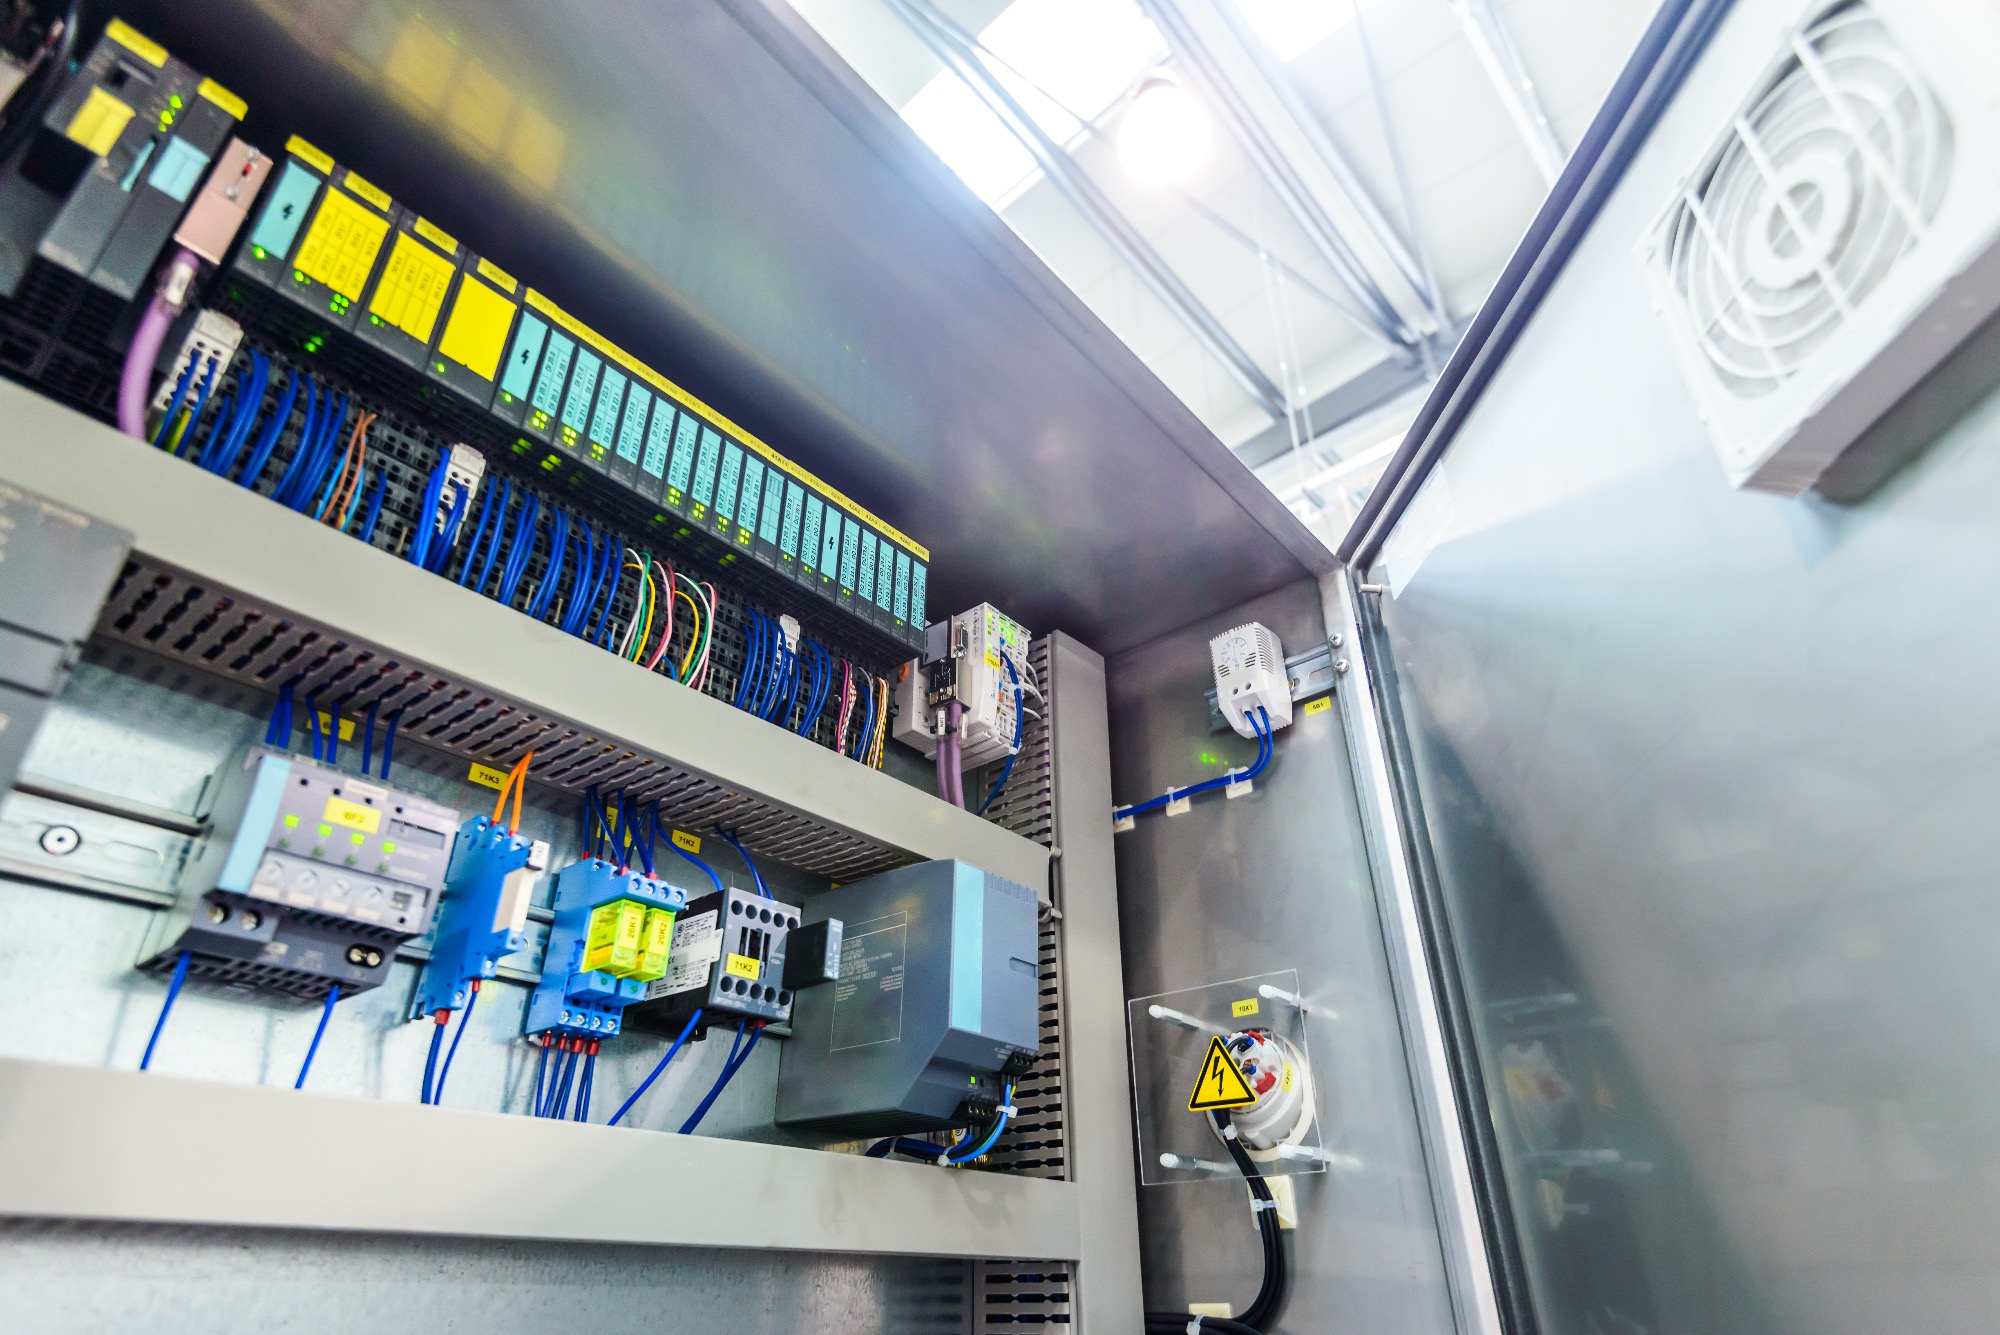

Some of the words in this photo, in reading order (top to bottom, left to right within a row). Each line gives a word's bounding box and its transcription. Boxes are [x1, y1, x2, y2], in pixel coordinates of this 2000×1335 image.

[545, 363, 552, 372] DI
[556, 370, 564, 380] DI
[573, 378, 580, 387] DI
[584, 385, 592, 394] DI
[536, 394, 543, 403] DI
[599, 397, 606, 406] DI
[548, 401, 555, 411] DI
[610, 404, 617, 413] DI
[565, 409, 572, 418] DI
[626, 413, 632, 422] DI
[576, 416, 584, 425] DI
[636, 420, 643, 429] DI
[592, 428, 598, 437] DI
[651, 428, 657, 437] DI
[602, 434, 610, 443] DI
[661, 435, 668, 443] DI
[619, 443, 626, 452] DI
[676, 443, 682, 452] DI
[630, 450, 636, 459] DI
[685, 449, 691, 458] DI
[645, 458, 651, 467] DI
[699, 458, 705, 466] DI
[770, 452, 787, 467] 41A11
[655, 464, 662, 473] DI
[708, 464, 715, 472] DI
[670, 473, 676, 481] DI
[722, 471, 727, 480] DI
[680, 479, 686, 487] DI
[731, 477, 737, 485] DI
[694, 487, 700, 496] DI
[744, 485, 749, 493] DI
[704, 493, 710, 501] DI
[752, 490, 758, 498] DI
[717, 501, 723, 509] DI
[848, 502, 860, 514] 42A2
[726, 506, 732, 514] DI
[739, 514, 745, 522] DI
[748, 519, 754, 527] DI
[479, 772, 500, 784] 71K3
[678, 836, 695, 847] 71K2
[627, 916, 638, 939] 26K1
[658, 922, 668, 945] 26K2
[735, 961, 753, 972] 71K2
